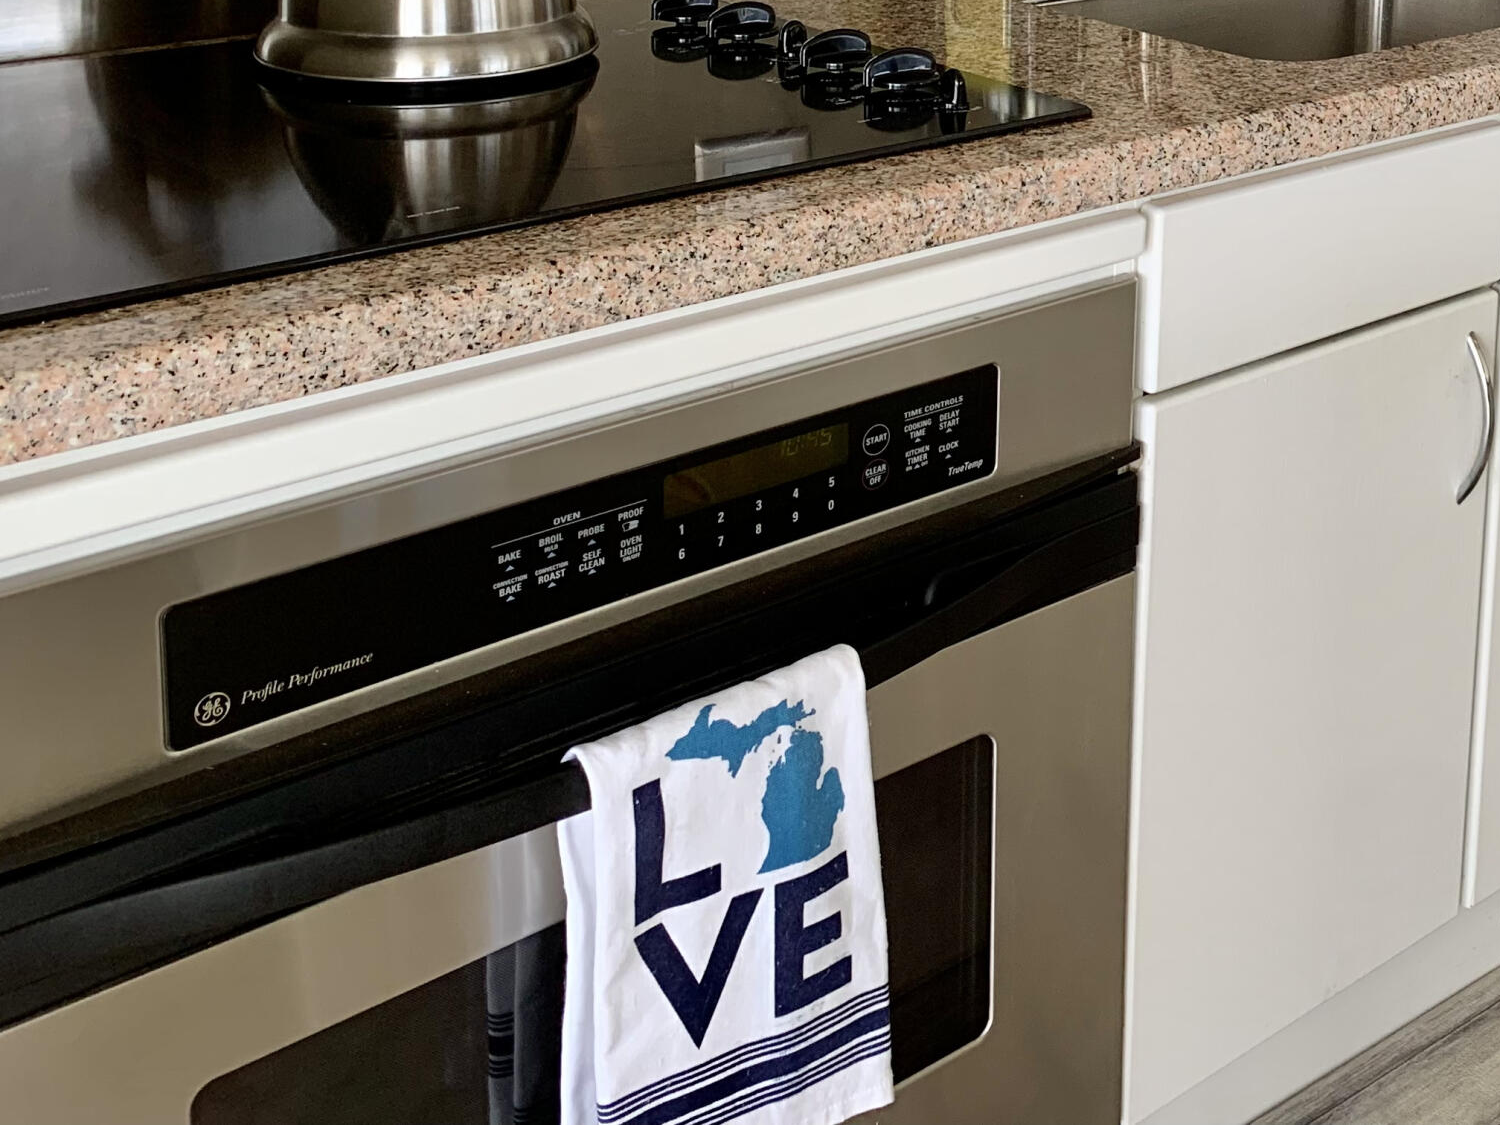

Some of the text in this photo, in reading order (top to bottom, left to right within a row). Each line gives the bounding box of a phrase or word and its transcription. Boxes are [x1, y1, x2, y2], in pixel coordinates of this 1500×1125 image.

[904, 395, 964, 419] TIME CONTROLS
[939, 409, 960, 422] DELAY
[904, 418, 932, 433] COOKING
[939, 417, 960, 430] START
[866, 432, 888, 446] START
[909, 428, 926, 440] TIME
[905, 445, 930, 458] KITCHEN
[938, 440, 960, 453] CLOCK
[907, 453, 928, 465] TIMER
[865, 463, 887, 476] CLEAR
[948, 459, 984, 476] TrueTemp
[869, 475, 882, 486] OFF
[679, 476, 835, 535] 1 2 3 4 5
[553, 511, 581, 526] OVEN
[617, 506, 645, 522] PROOF
[577, 523, 606, 539] PROBE
[678, 499, 835, 559] 6 7 8 9 0
[538, 533, 564, 548] BROIL
[620, 534, 643, 548] OVEN
[498, 549, 521, 565] BAKE
[582, 548, 602, 562] SELF
[620, 543, 643, 558] LIGHT
[534, 560, 569, 576] CONVECTION
[578, 557, 606, 572] CLEAN
[492, 573, 528, 590] CONVECTION
[537, 568, 566, 585] ROAST
[499, 582, 522, 597] BAKE
[240, 652, 374, 705] Profile Performance
